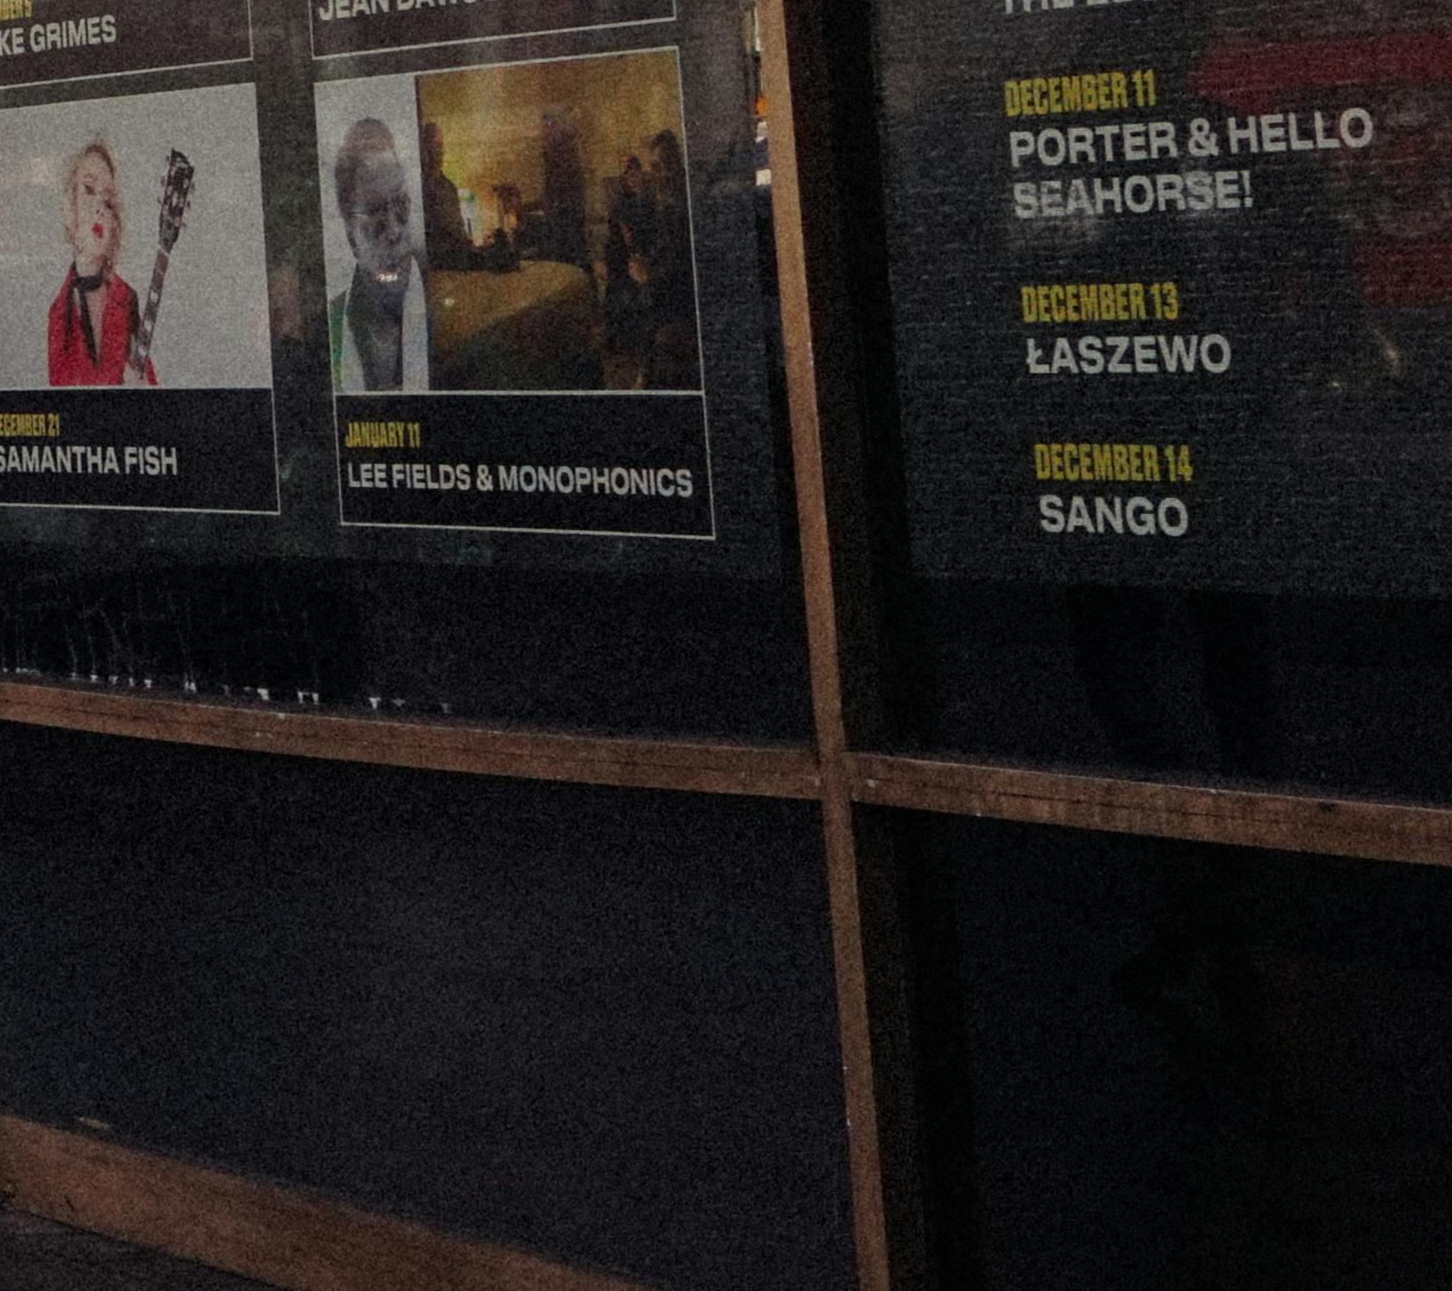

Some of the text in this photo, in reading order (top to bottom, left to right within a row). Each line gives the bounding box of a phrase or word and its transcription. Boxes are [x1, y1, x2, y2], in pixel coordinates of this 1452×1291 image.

[29, 13, 118, 52] GRIMES
[1005, 69, 1157, 118] DECEMBER 11
[1010, 107, 1375, 168] PORTER & HELLO
[1013, 170, 1255, 220] SEAHORSE!
[1021, 282, 1180, 323] DECEMBER 13
[124, 445, 179, 476] FISH
[347, 461, 694, 499] LEE FIELDS & MONOPHONICS
[1035, 443, 1194, 483] DECEMBER 14
[1040, 493, 1189, 538] SANGO
